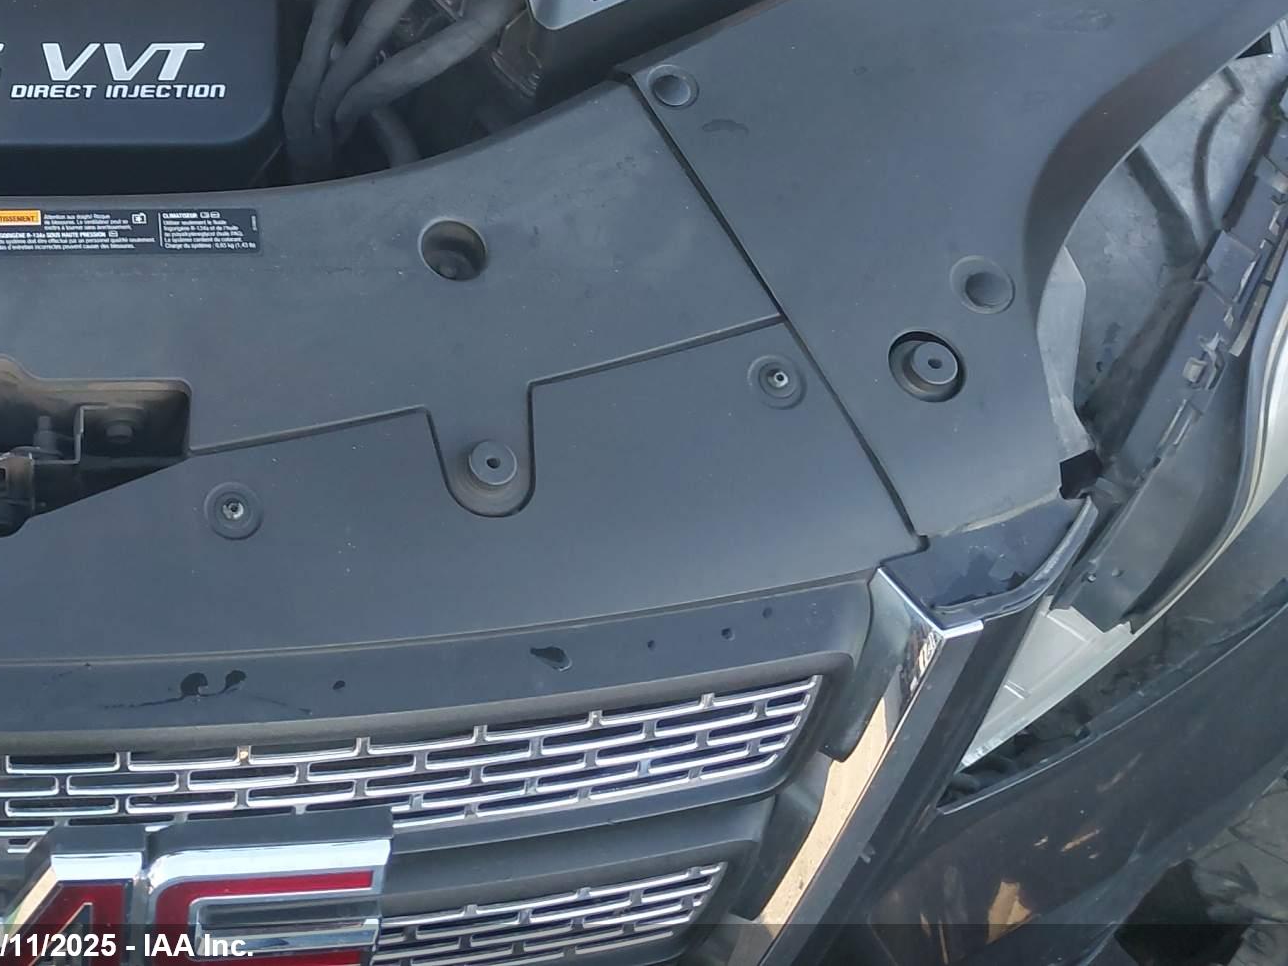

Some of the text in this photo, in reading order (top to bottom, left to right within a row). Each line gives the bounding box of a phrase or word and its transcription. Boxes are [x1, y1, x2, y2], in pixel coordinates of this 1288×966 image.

[42, 42, 205, 81] VVT
[11, 84, 226, 98] DIRECT INJECTION
